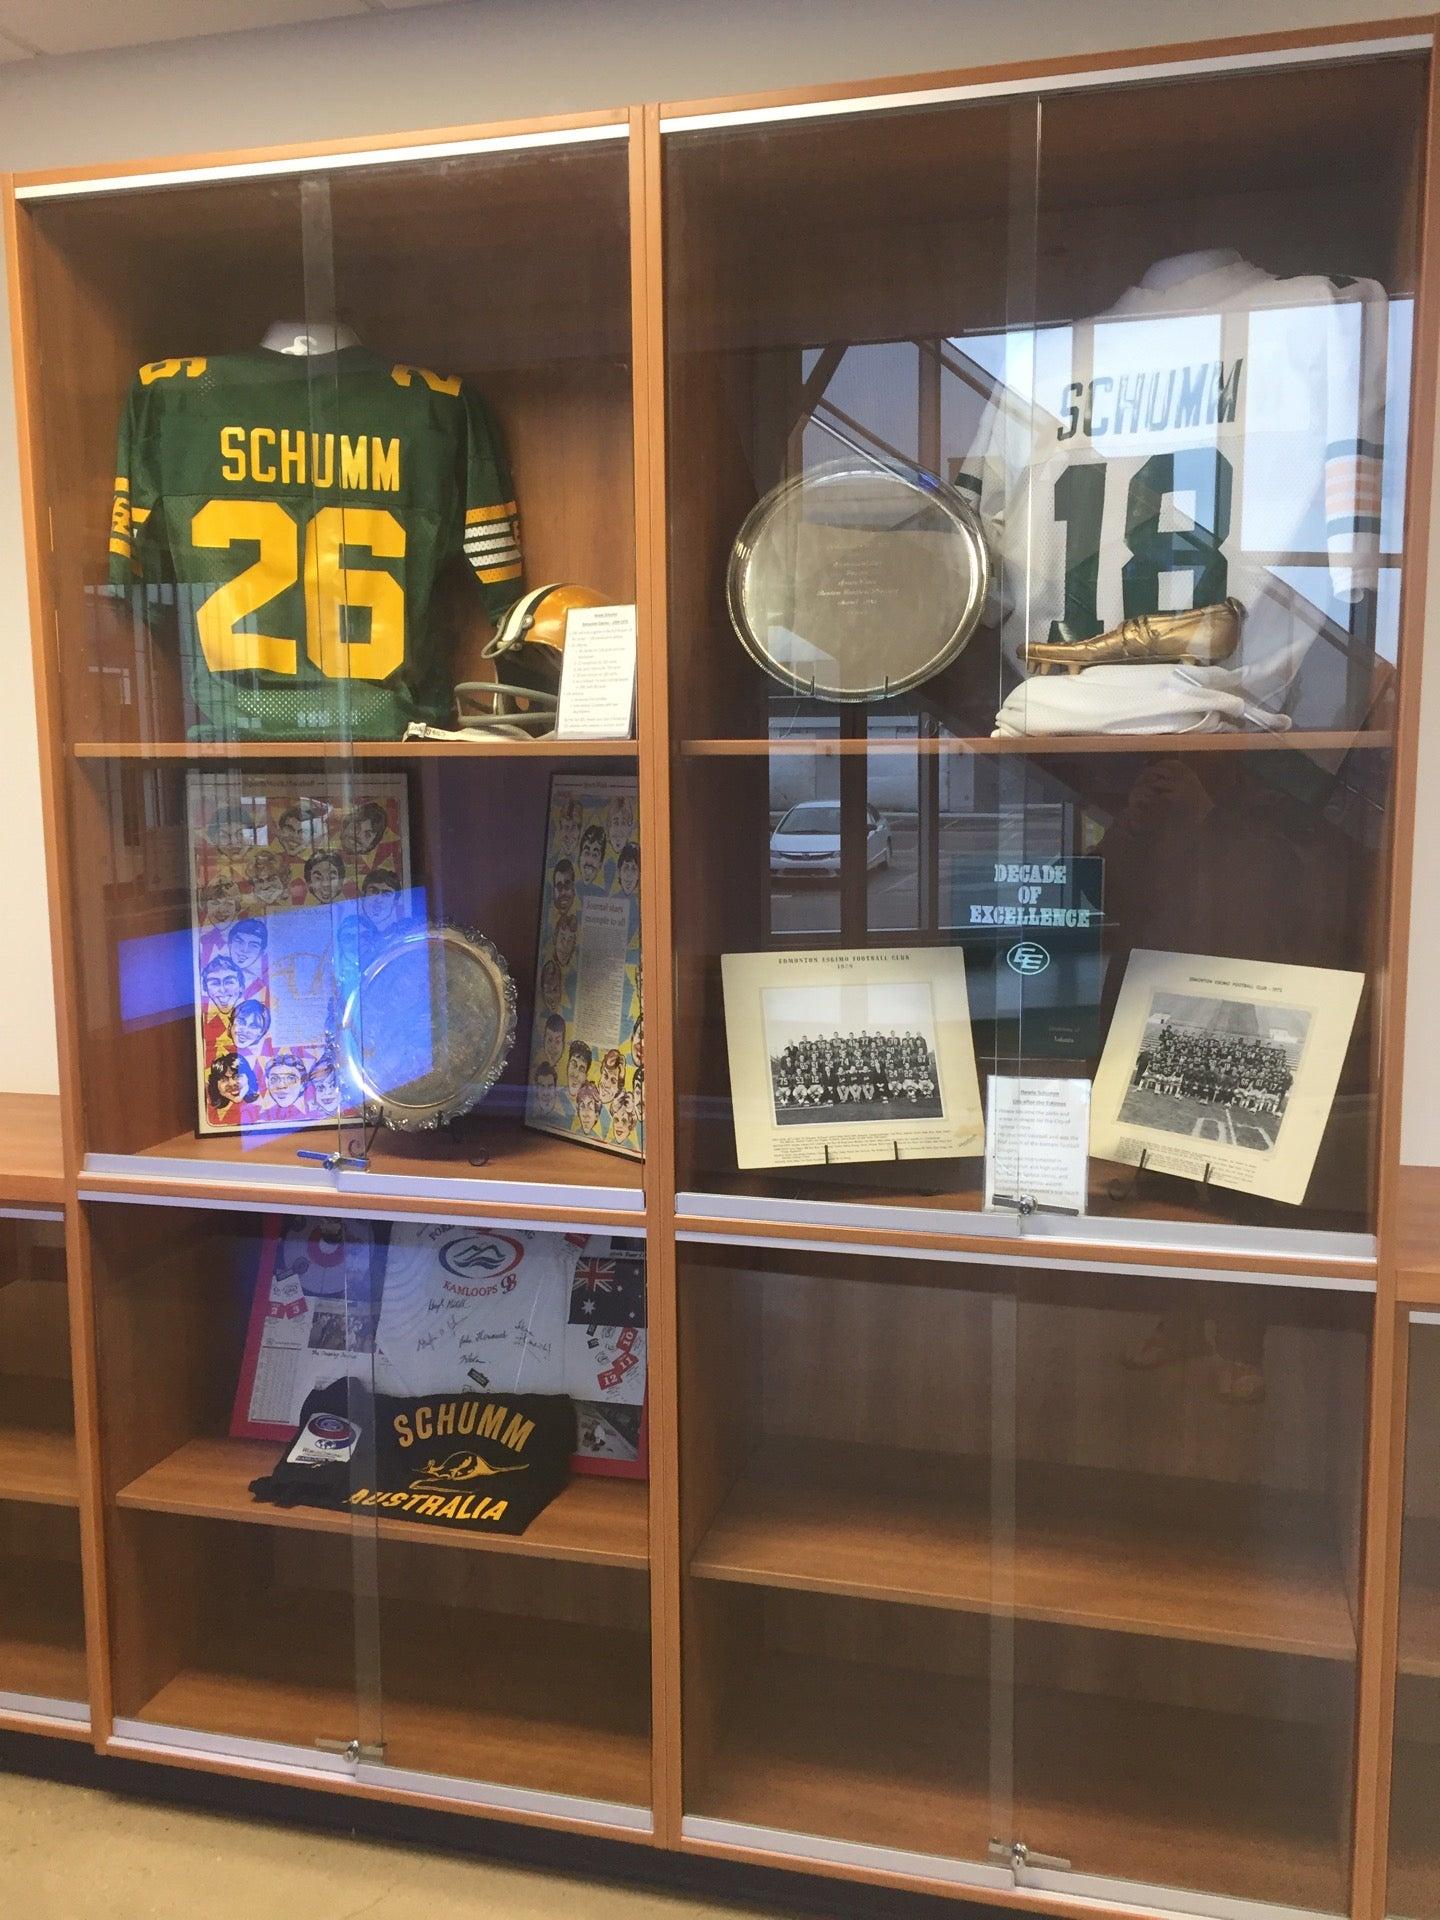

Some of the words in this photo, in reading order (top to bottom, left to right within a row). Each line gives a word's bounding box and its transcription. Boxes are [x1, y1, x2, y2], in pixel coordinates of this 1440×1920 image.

[1056, 358, 1244, 442] SCHUMM
[220, 426, 400, 492] SCHUMM
[1048, 447, 1233, 643] 18
[191, 499, 407, 681] 26
[994, 863, 1067, 884] DECADE
[1018, 885, 1042, 905] OF
[969, 904, 1090, 928] EXCELLENCE
[821, 956, 850, 964] ESKIMO
[852, 954, 888, 962] FOOTBALL
[443, 1279, 498, 1297] KAMLOOPS
[393, 1401, 537, 1454] SCHUMM
[341, 1487, 510, 1522] AUSTRALIA
